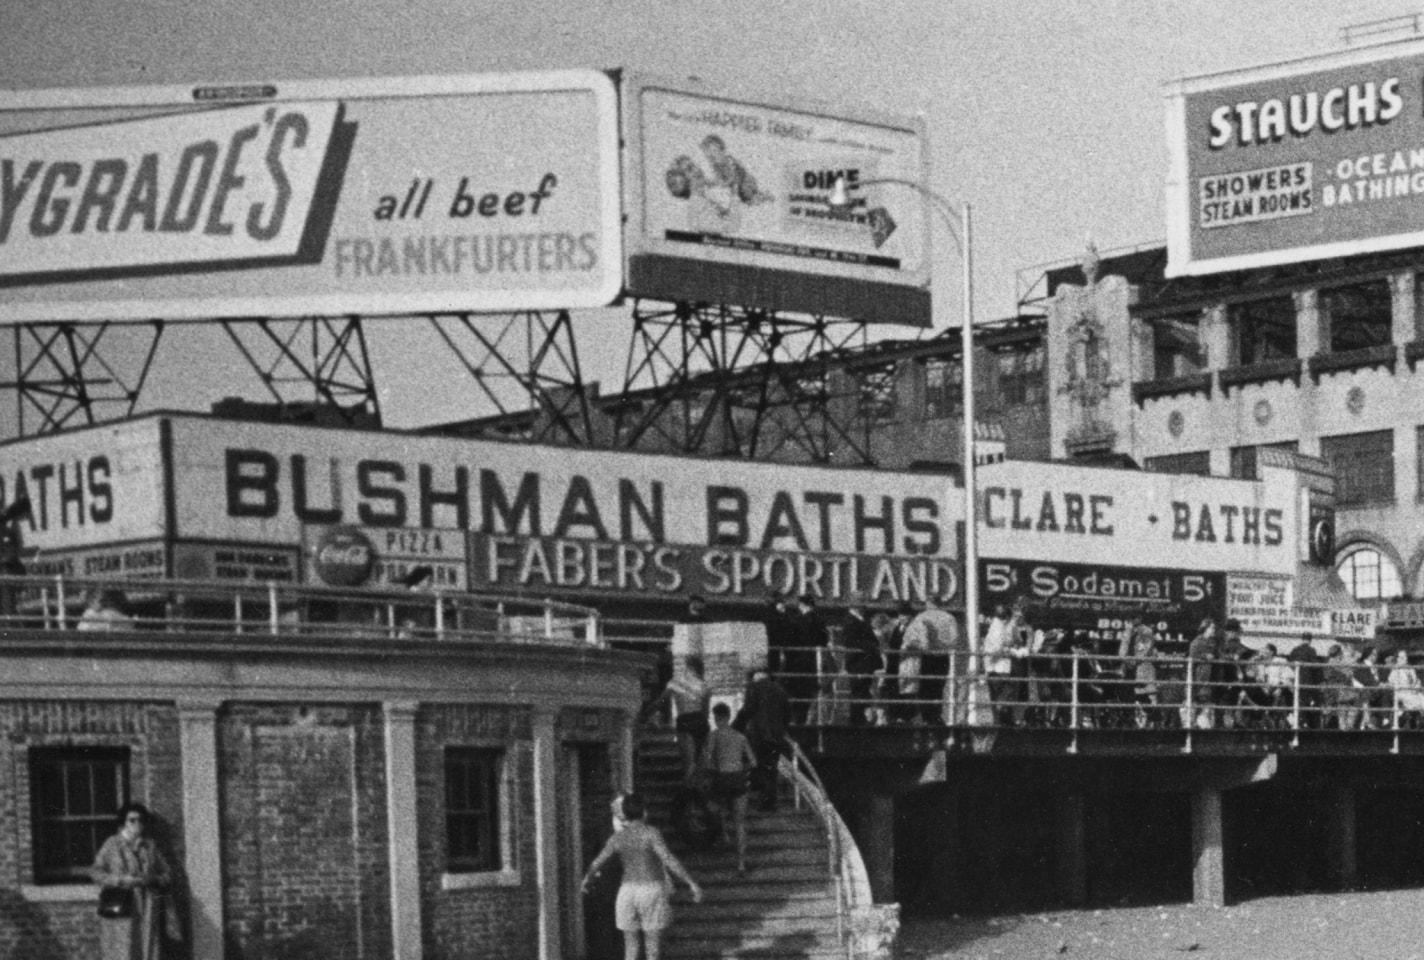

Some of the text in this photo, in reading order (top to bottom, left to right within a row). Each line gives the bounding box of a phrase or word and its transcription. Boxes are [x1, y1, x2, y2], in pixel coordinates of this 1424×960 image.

[1208, 76, 1404, 148] STAUCHS
[374, 172, 557, 220] all beef
[1202, 190, 1312, 223] STEAM ROOMS
[1204, 166, 1307, 199] SHOWERS
[335, 232, 598, 278] FRANKFURTERS
[226, 447, 942, 555] BUSHMAN BATHS
[984, 487, 1284, 546] CLARE BATHS
[386, 531, 443, 553] PIZZA
[488, 537, 958, 604] FABER'S SPORTLAND
